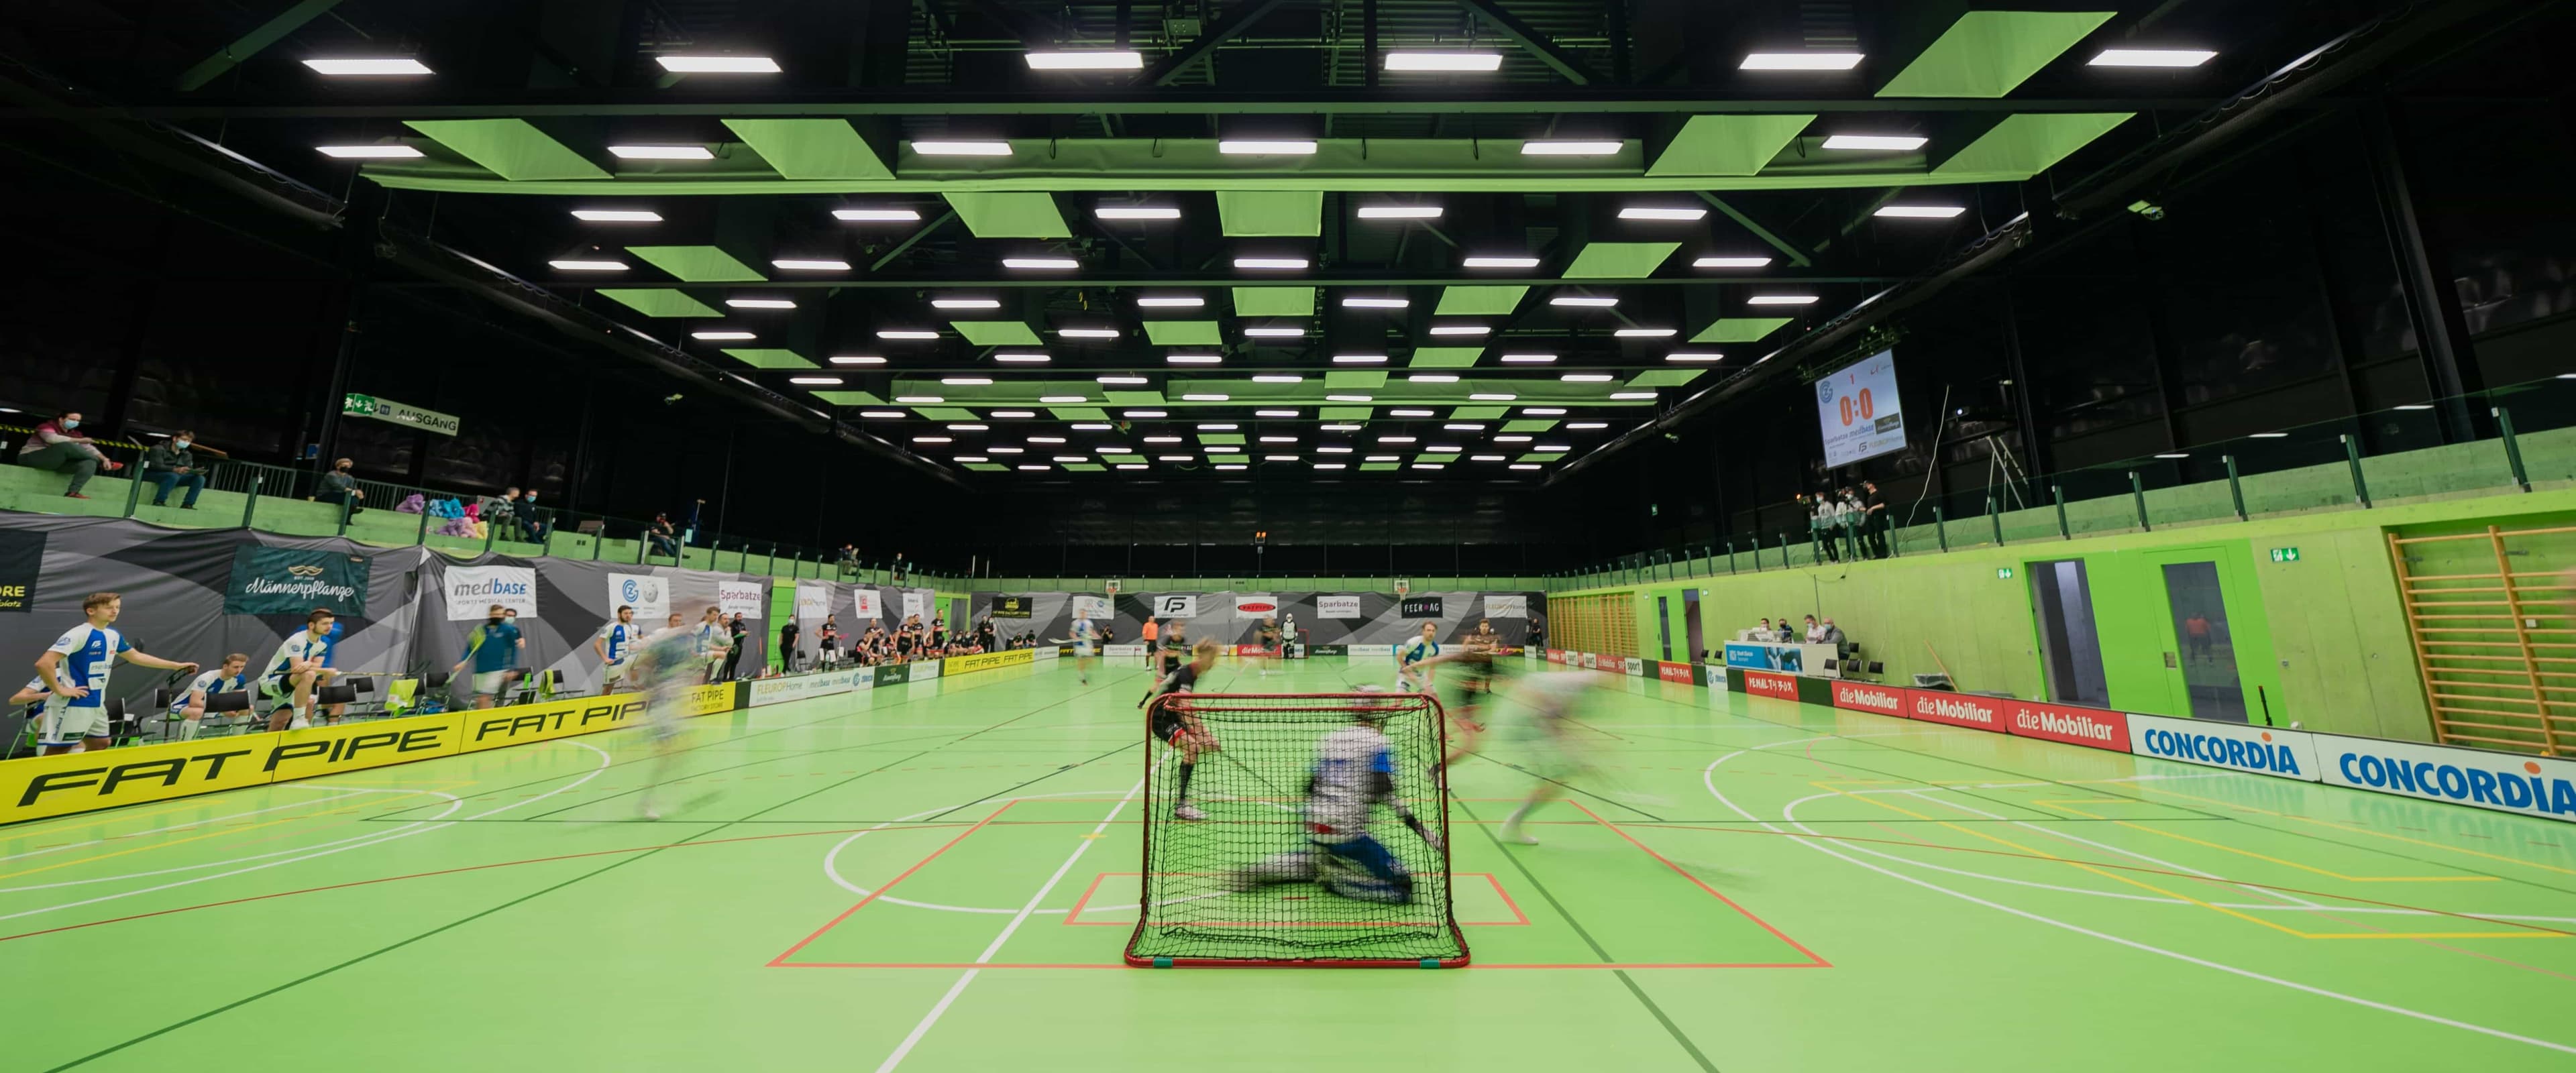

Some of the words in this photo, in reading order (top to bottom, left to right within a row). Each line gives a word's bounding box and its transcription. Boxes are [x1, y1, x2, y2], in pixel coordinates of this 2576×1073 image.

[1839, 388, 1874, 427] 0:0
[398, 410, 457, 431] AUSGANG
[0, 585, 25, 597] RE
[246, 577, 354, 602] Männerpflanze
[720, 590, 761, 601] Sparbatze
[1405, 604, 1423, 612] FEER
[1430, 603, 1440, 612] AG
[965, 659, 980, 669] FAT
[981, 656, 1000, 666] PIPE
[1004, 654, 1018, 663] FAT
[1019, 652, 1033, 661] PIPE
[1627, 661, 1641, 673] sport
[1661, 667, 1679, 677] PENALTY
[1679, 668, 1690, 678] BOX
[1748, 677, 1777, 691] PENALTY
[1778, 678, 1794, 693] BOX
[692, 691, 706, 703] FAT
[707, 689, 724, 701] PIPE
[1840, 687, 1854, 703] die
[1855, 689, 1898, 710] Mobiliar
[1917, 697, 1935, 716] die
[1936, 699, 1993, 724] Mobiliar
[476, 710, 576, 742] FAT
[2017, 708, 2039, 730] die
[2041, 711, 2113, 741] Mobiliar
[2145, 728, 2301, 776] CONCORDIA
[17, 750, 252, 807] FAT
[262, 726, 448, 773] PIPE
[2340, 752, 2576, 817] CONCORDIA
